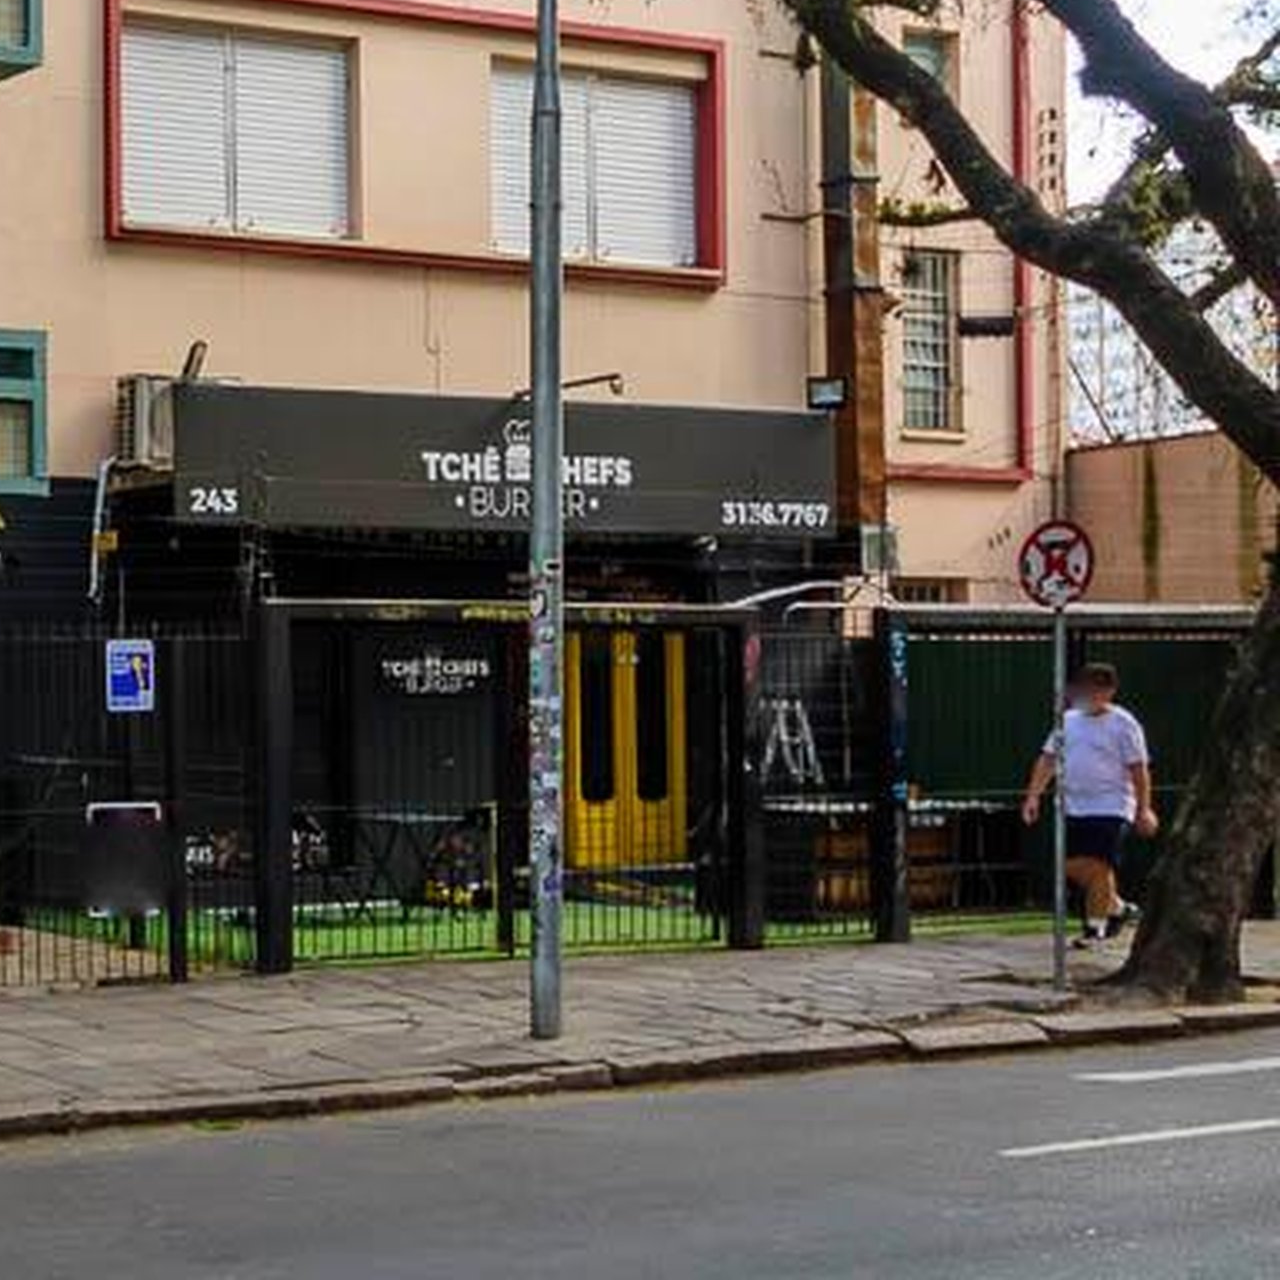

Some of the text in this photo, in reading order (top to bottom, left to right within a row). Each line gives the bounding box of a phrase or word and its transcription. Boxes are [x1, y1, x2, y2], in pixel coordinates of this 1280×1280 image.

[421, 445, 633, 485] TCHÊ HEFS
[190, 487, 238, 512] 243
[468, 484, 587, 518] BURR
